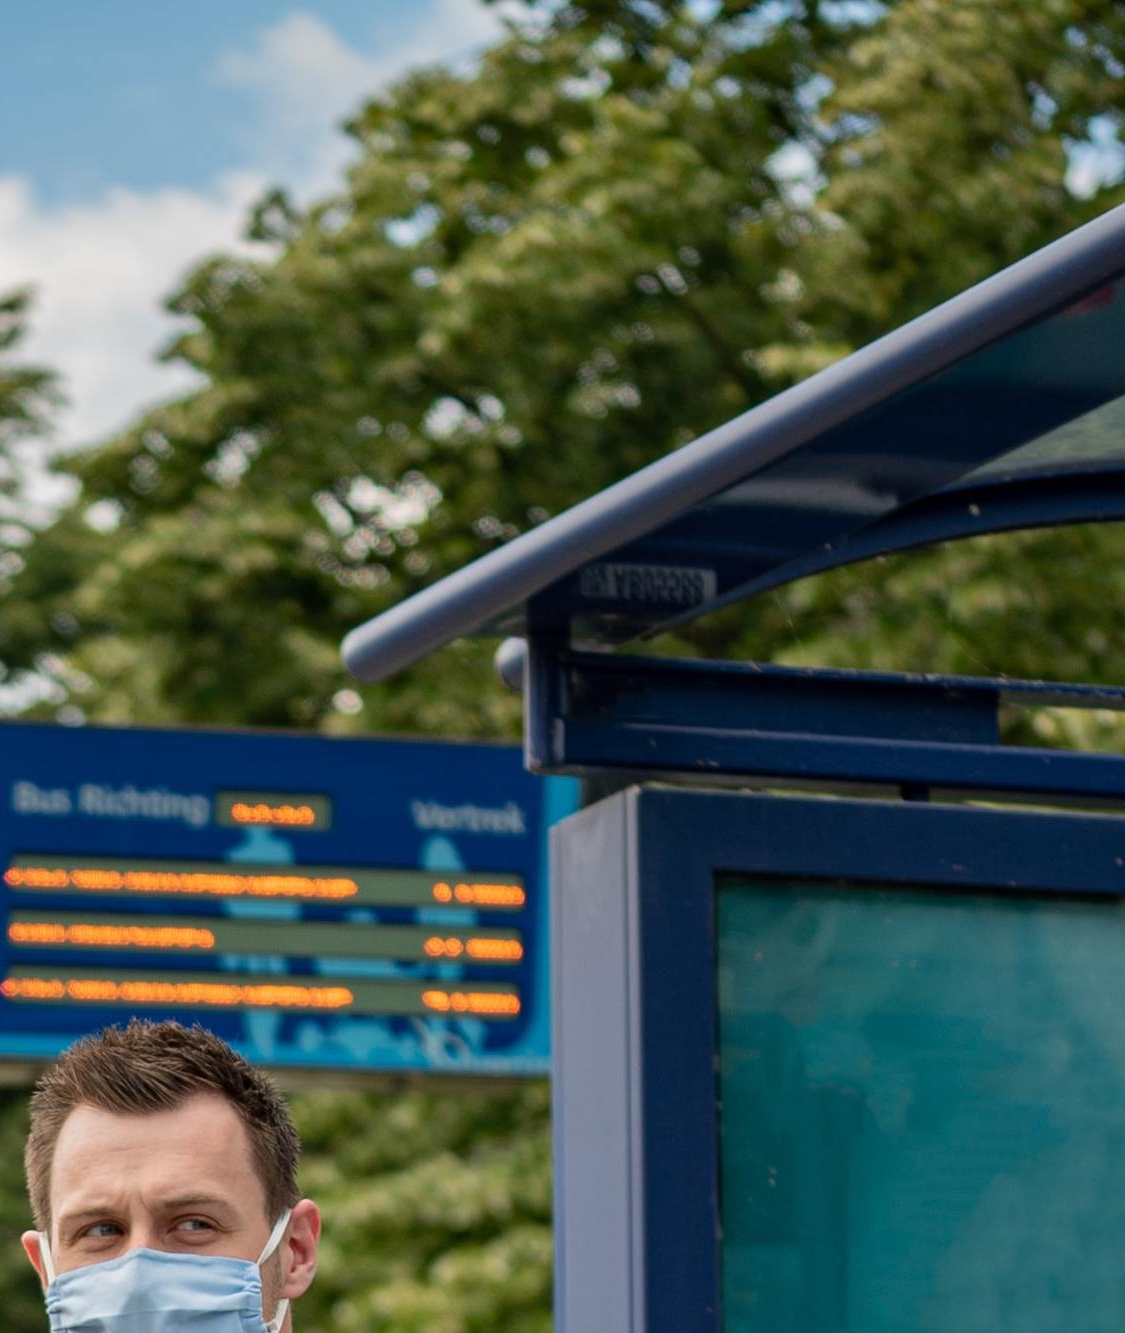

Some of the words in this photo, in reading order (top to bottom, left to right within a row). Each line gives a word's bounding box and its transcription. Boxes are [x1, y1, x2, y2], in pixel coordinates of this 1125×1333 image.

[12, 780, 72, 815] Bus
[79, 783, 210, 828] Richting
[411, 799, 526, 834] Vertrek
